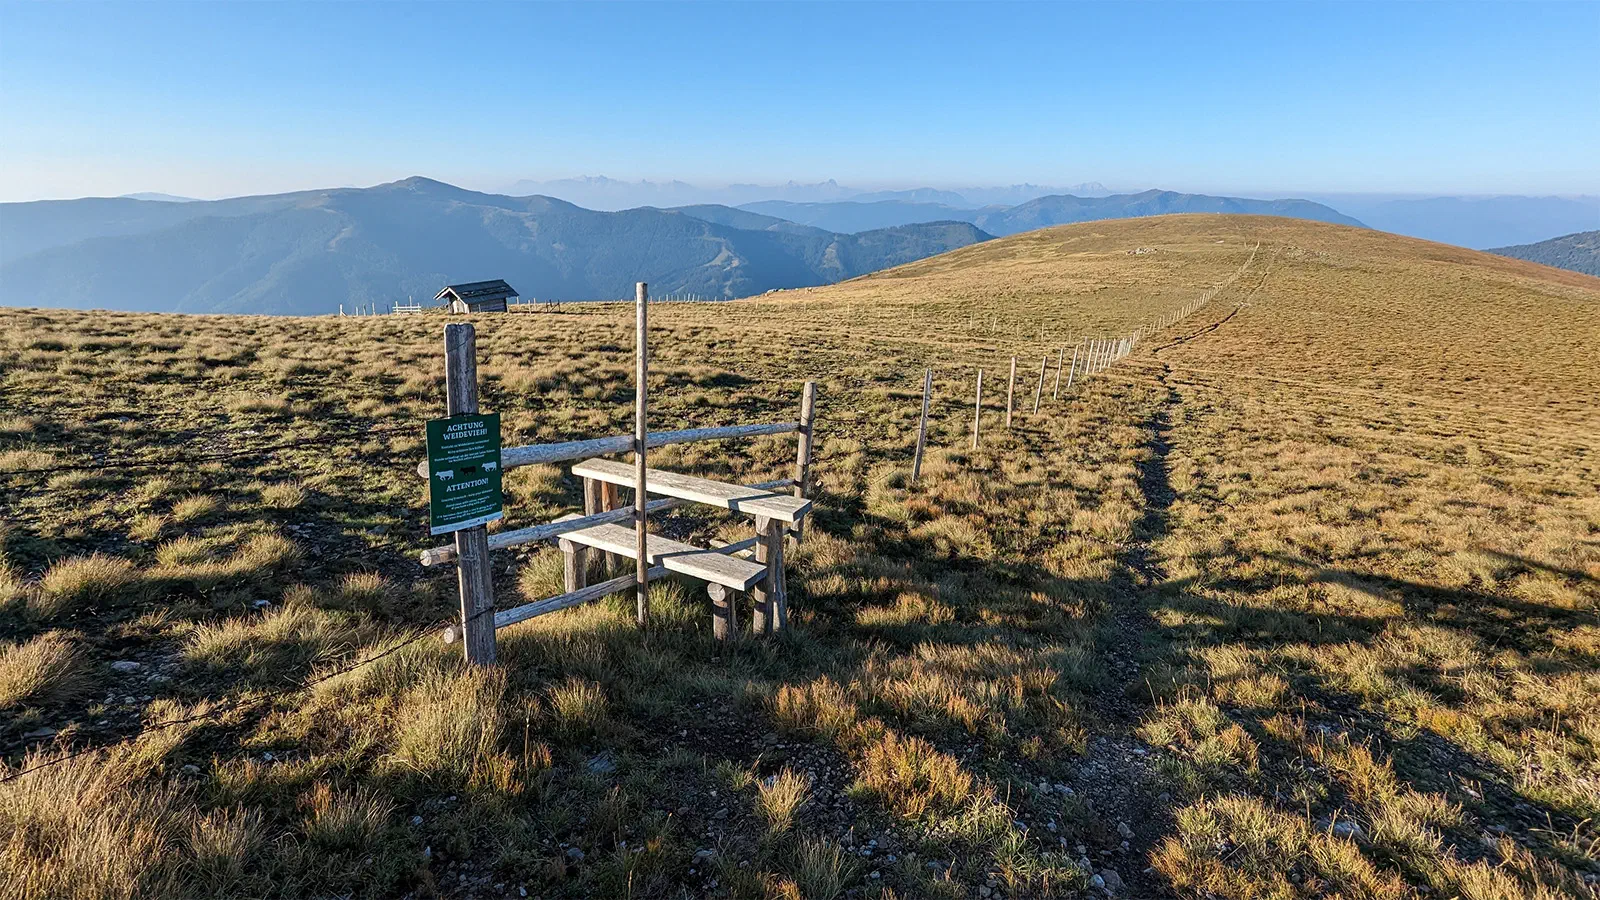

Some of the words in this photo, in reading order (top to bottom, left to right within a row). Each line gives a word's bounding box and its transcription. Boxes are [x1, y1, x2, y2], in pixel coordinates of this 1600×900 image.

[447, 421, 484, 432] ACHTUNG
[443, 428, 488, 440] WEIDEVIEH!
[446, 478, 489, 492] ATTENTION!
